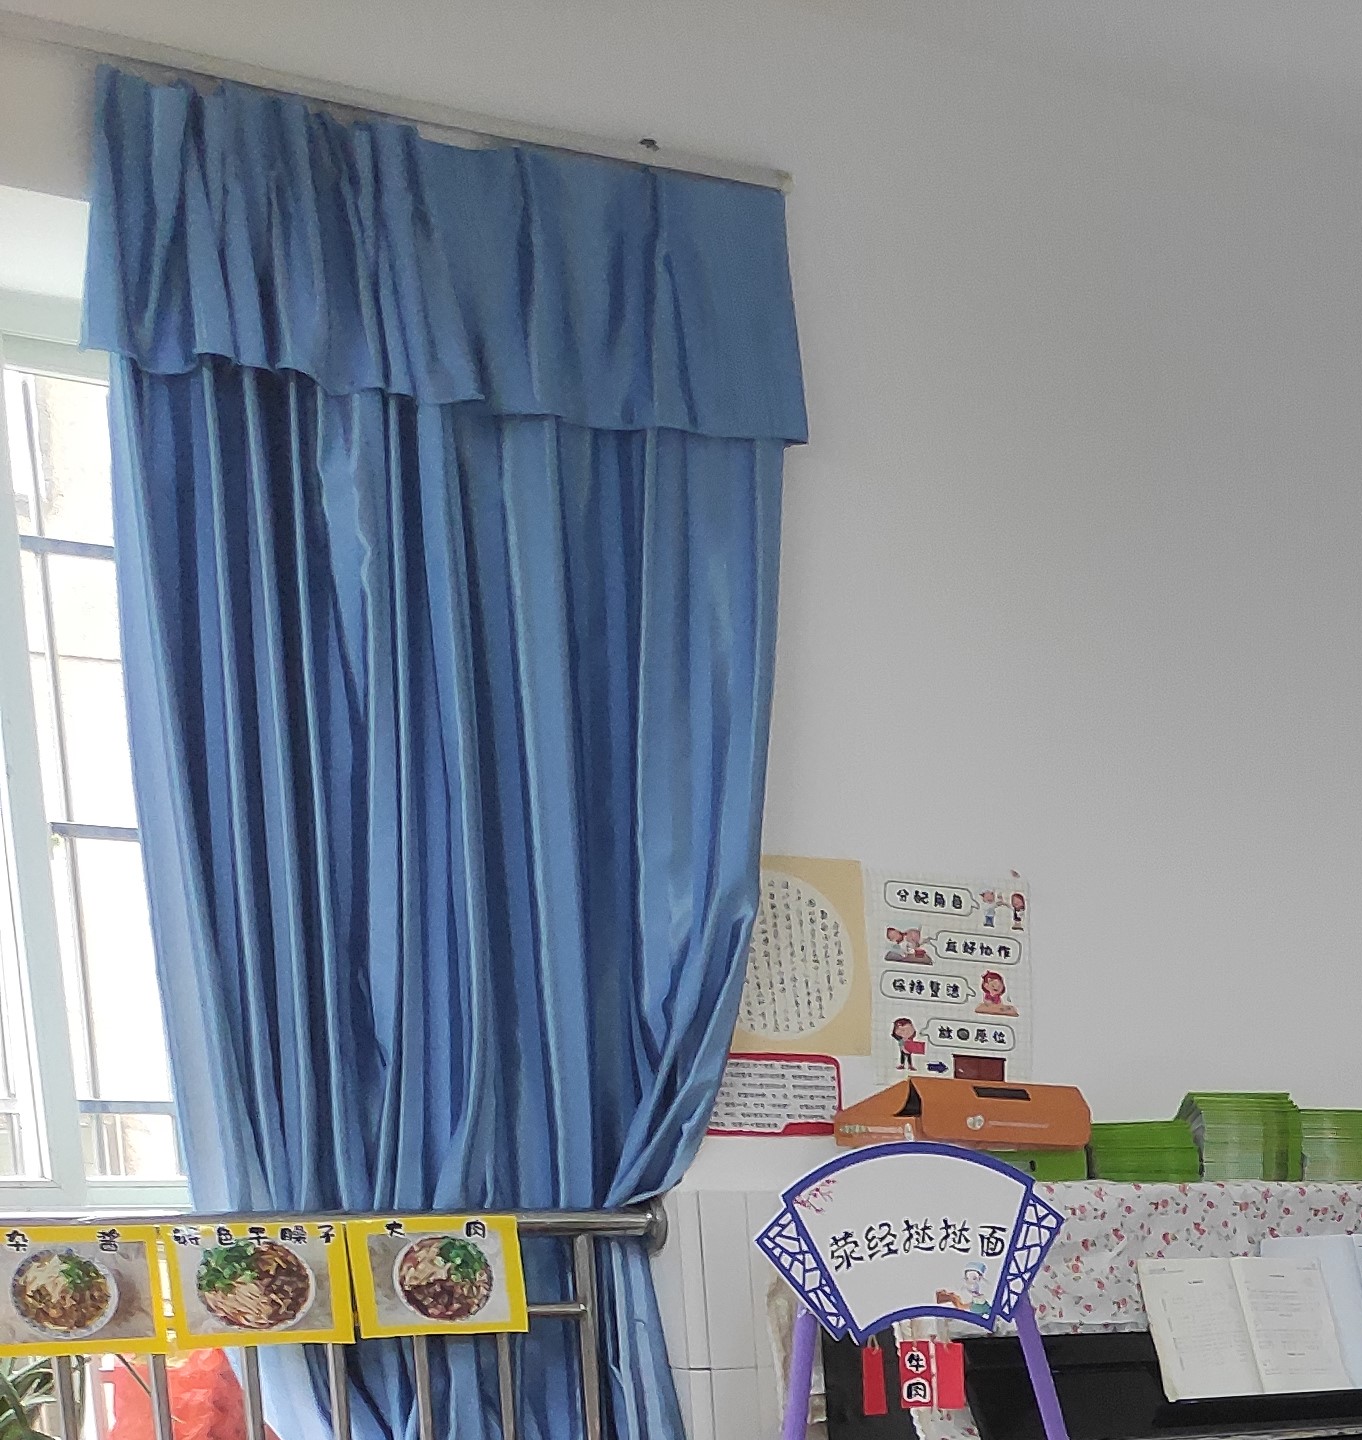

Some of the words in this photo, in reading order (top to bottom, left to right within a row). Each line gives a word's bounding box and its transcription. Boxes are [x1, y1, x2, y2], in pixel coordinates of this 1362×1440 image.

[828, 1217, 1010, 1273] 荥经挞挞面
